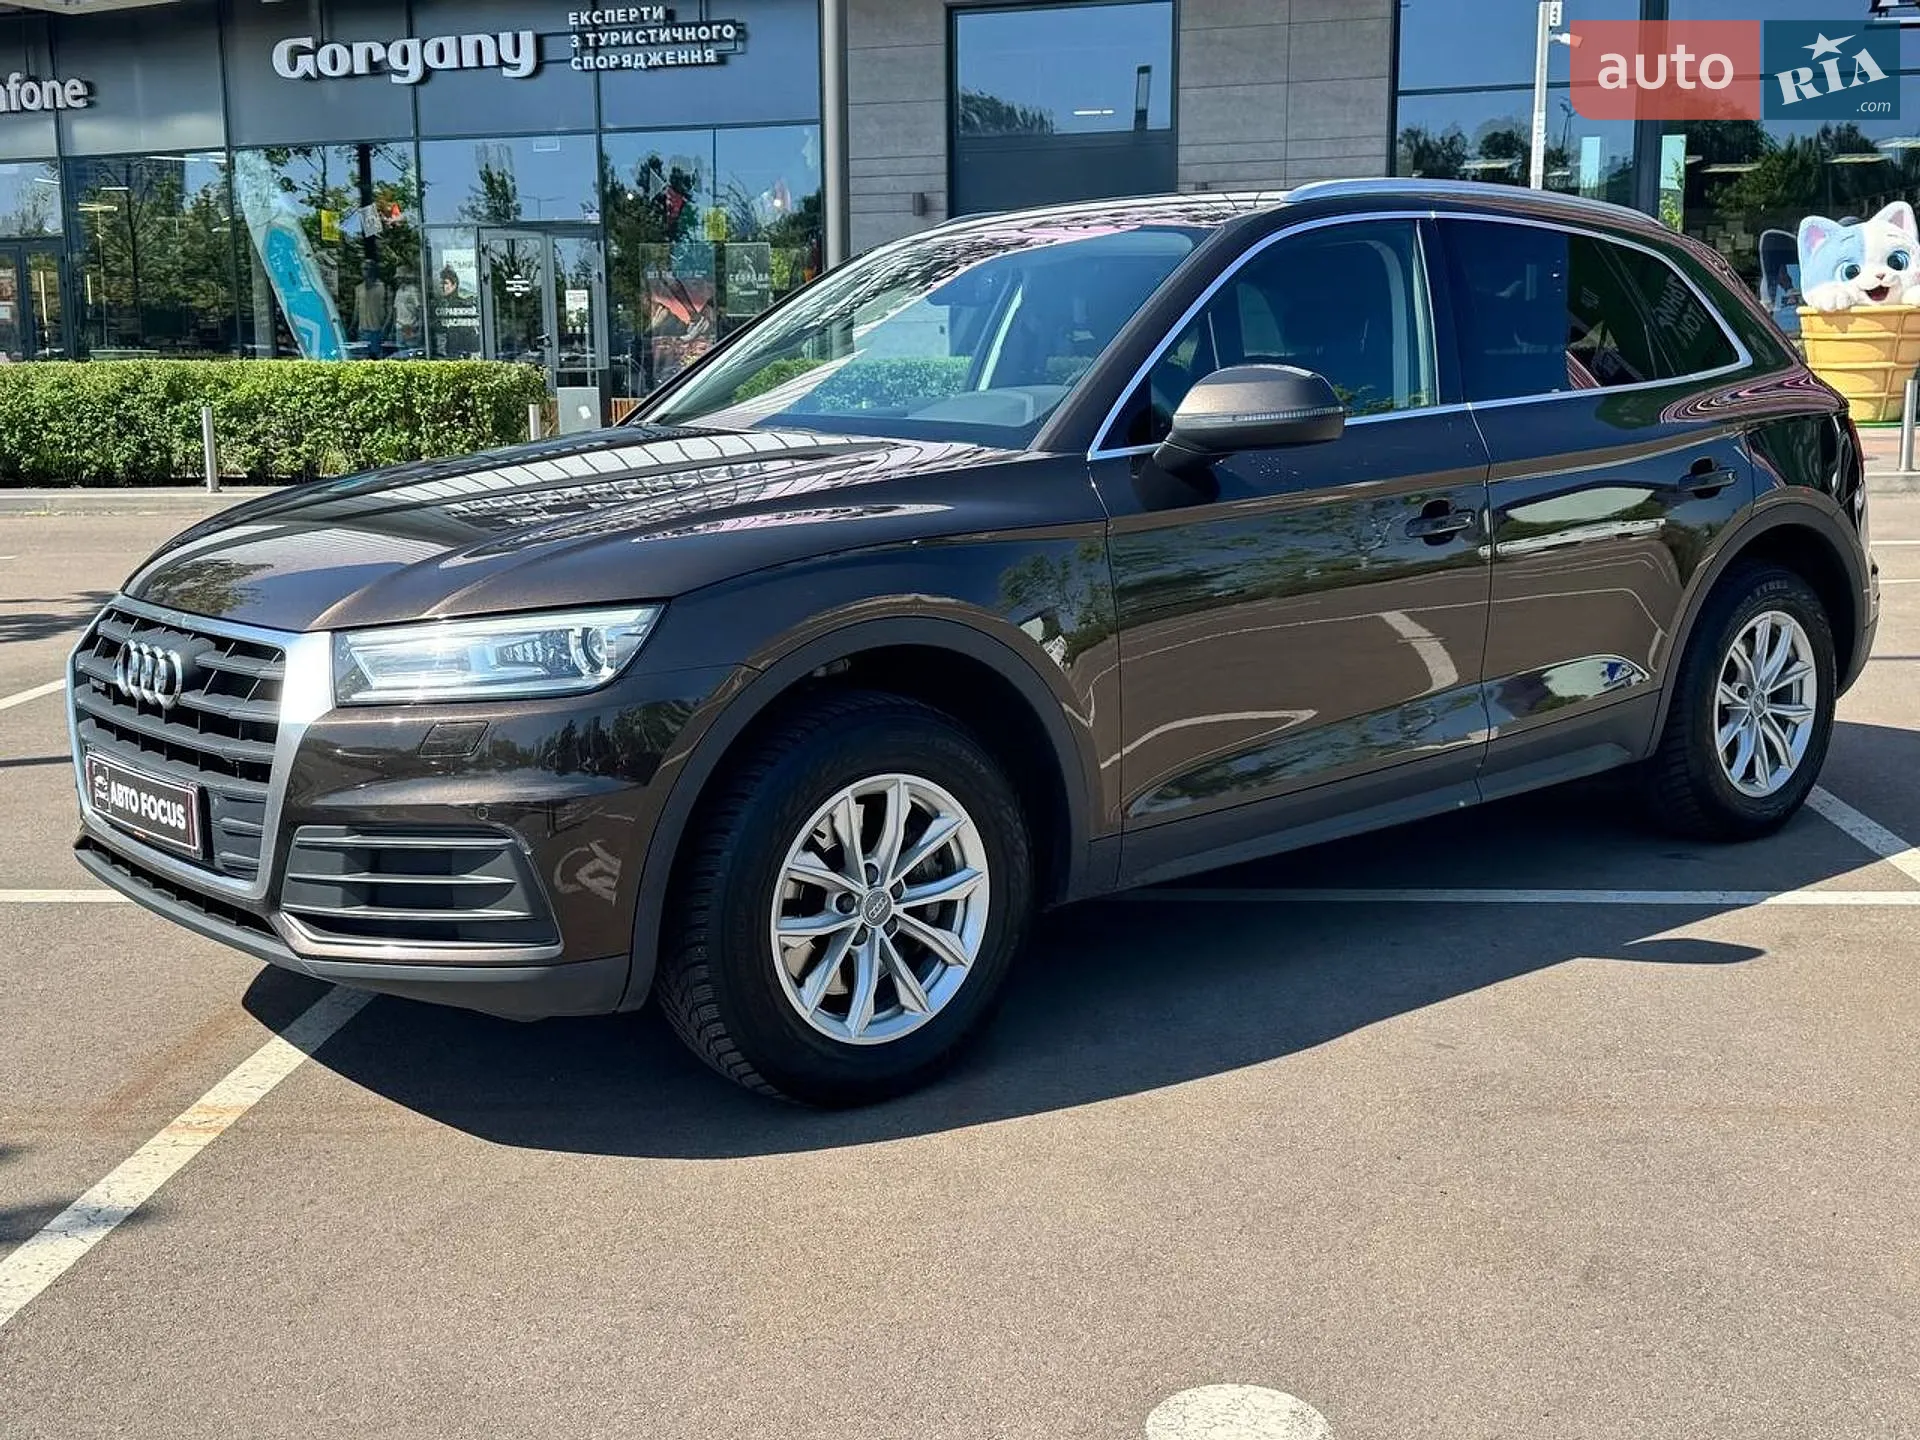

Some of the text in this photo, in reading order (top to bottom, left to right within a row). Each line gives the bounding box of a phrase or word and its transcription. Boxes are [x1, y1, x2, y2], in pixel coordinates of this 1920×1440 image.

[568, 6, 665, 25] ЕКСПЕРТИ
[586, 25, 735, 48] ТУРИСТИЧНОГО
[272, 30, 536, 84] Gorgany
[571, 49, 718, 71] СПОРЯДЖЕННЯ
[140, 792, 186, 830] FOCUS
